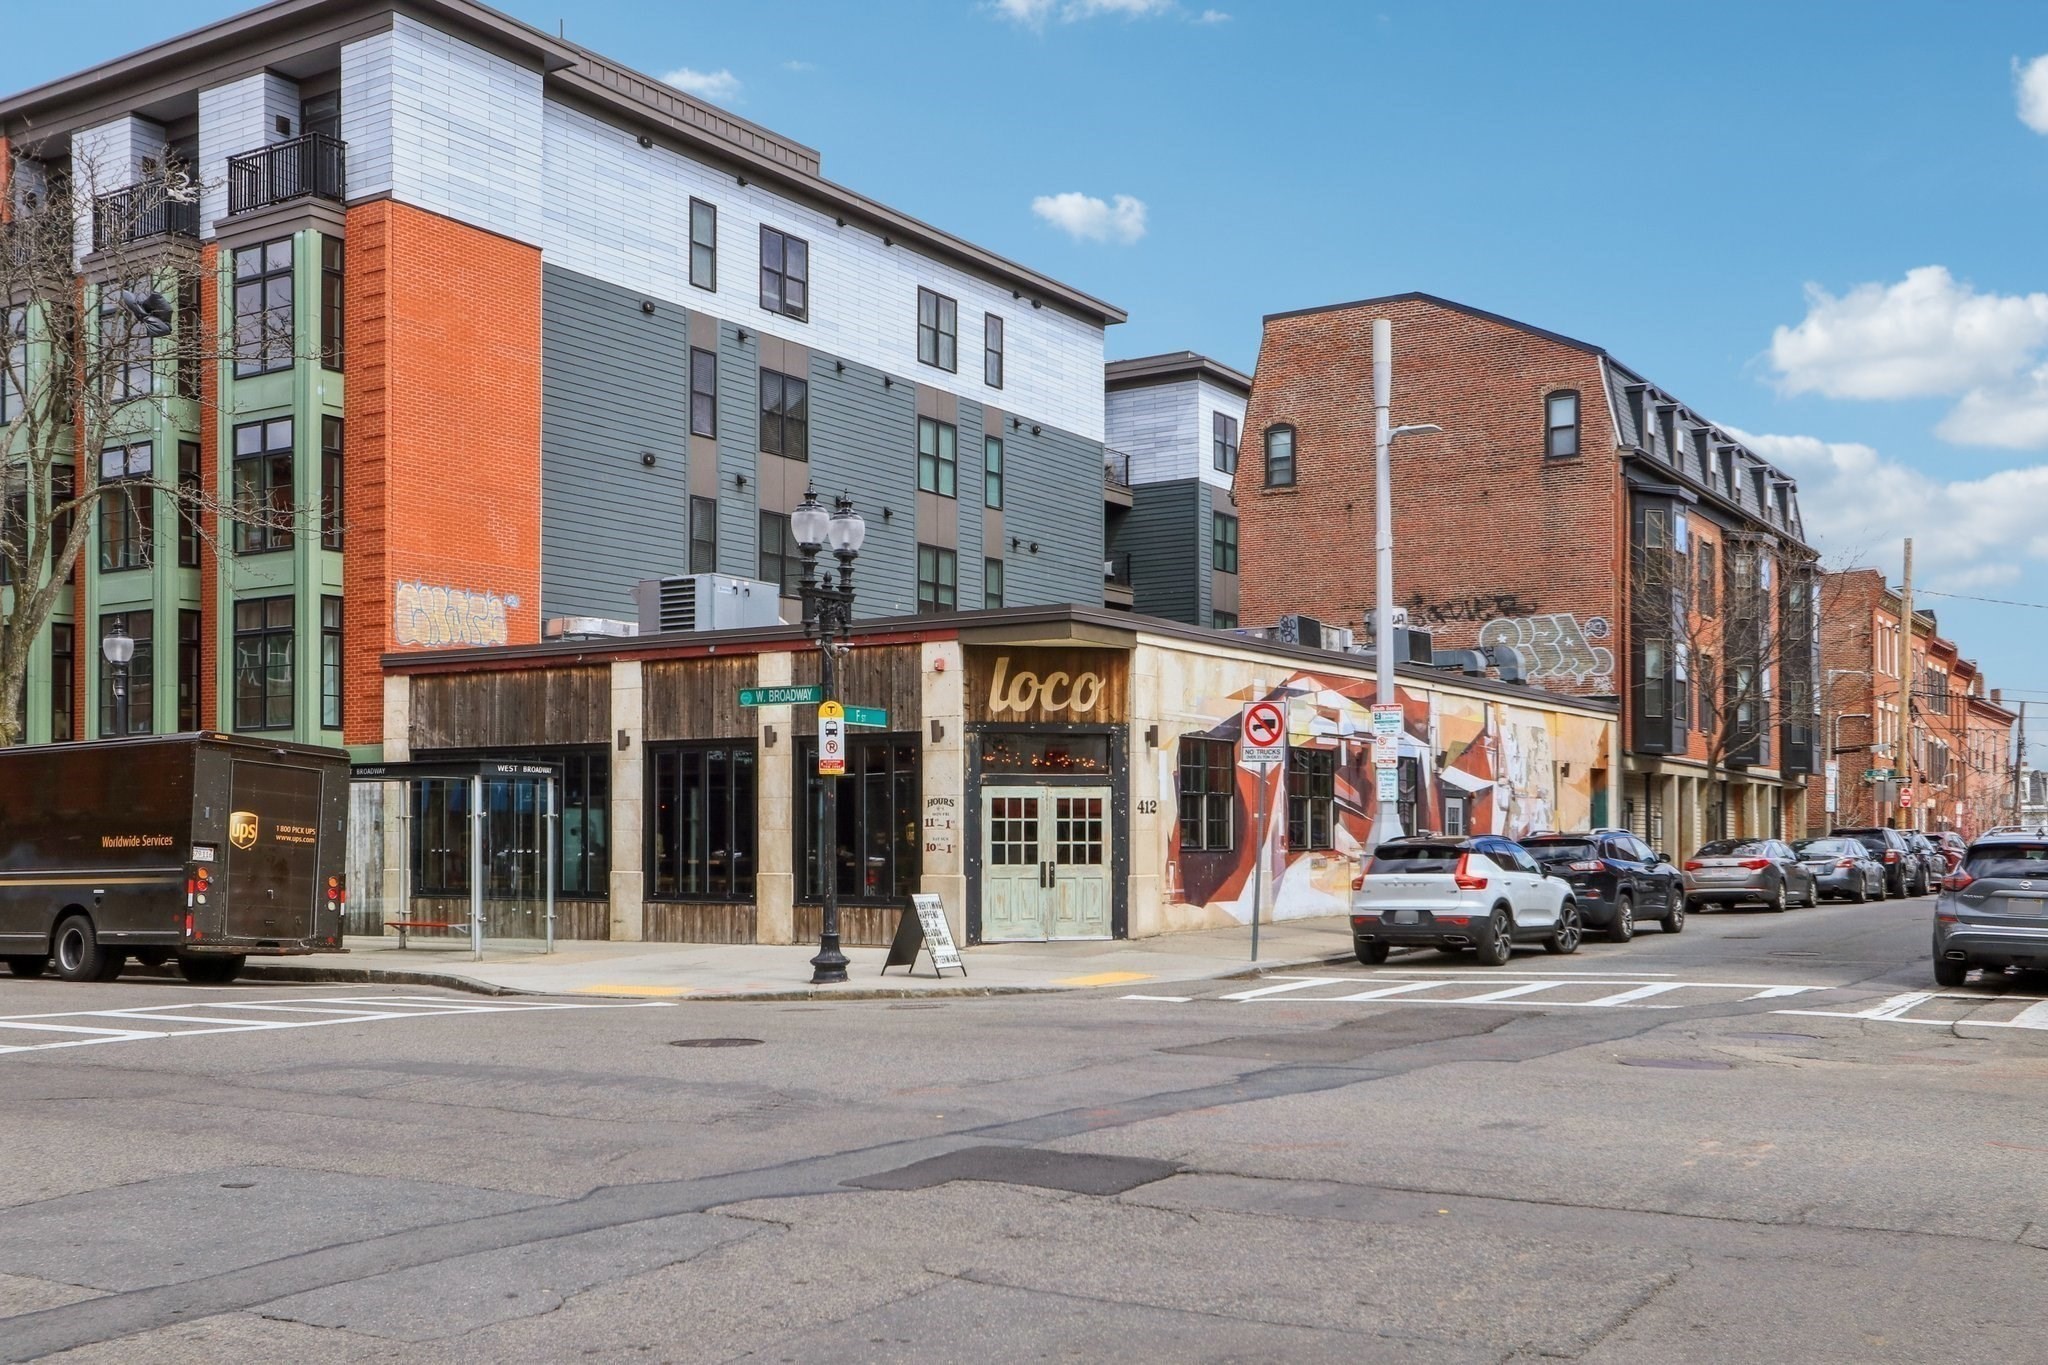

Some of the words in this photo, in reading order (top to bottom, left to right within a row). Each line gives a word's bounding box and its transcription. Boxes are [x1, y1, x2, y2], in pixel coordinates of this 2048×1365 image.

[988, 656, 1106, 712] loco
[756, 690, 766, 702] W.
[768, 688, 812, 702] BROADWAY
[856, 710, 860, 722] F
[927, 797, 955, 808] HOURS
[1137, 800, 1157, 814] 412
[231, 823, 256, 843] ups
[280, 825, 291, 833] 800
[292, 826, 304, 834] PICK
[305, 827, 316, 835] UPS
[102, 835, 140, 848] Worldwide
[142, 834, 173, 847] Services
[275, 834, 315, 843] www.ups.com
[919, 910, 938, 919] HAPPENS
[924, 928, 942, 937] REASON
[936, 937, 949, 946] MAKE
